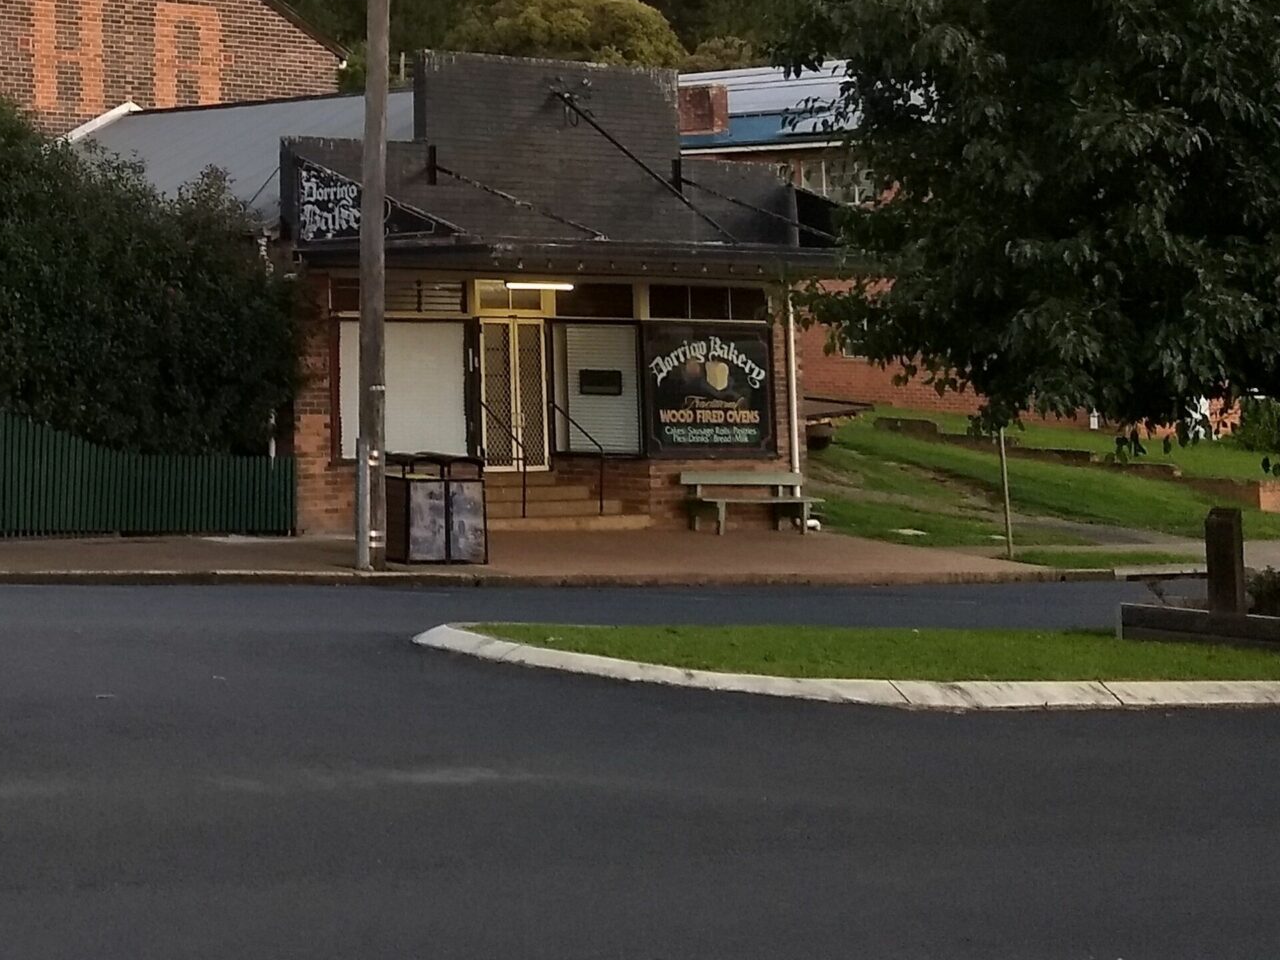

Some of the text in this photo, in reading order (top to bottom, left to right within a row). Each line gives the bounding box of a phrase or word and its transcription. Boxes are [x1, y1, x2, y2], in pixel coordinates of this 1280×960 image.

[301, 178, 358, 207] Dorrigo
[649, 336, 766, 389] Dorrigo Bakery
[659, 409, 760, 424] WOOD FIRED OVENS
